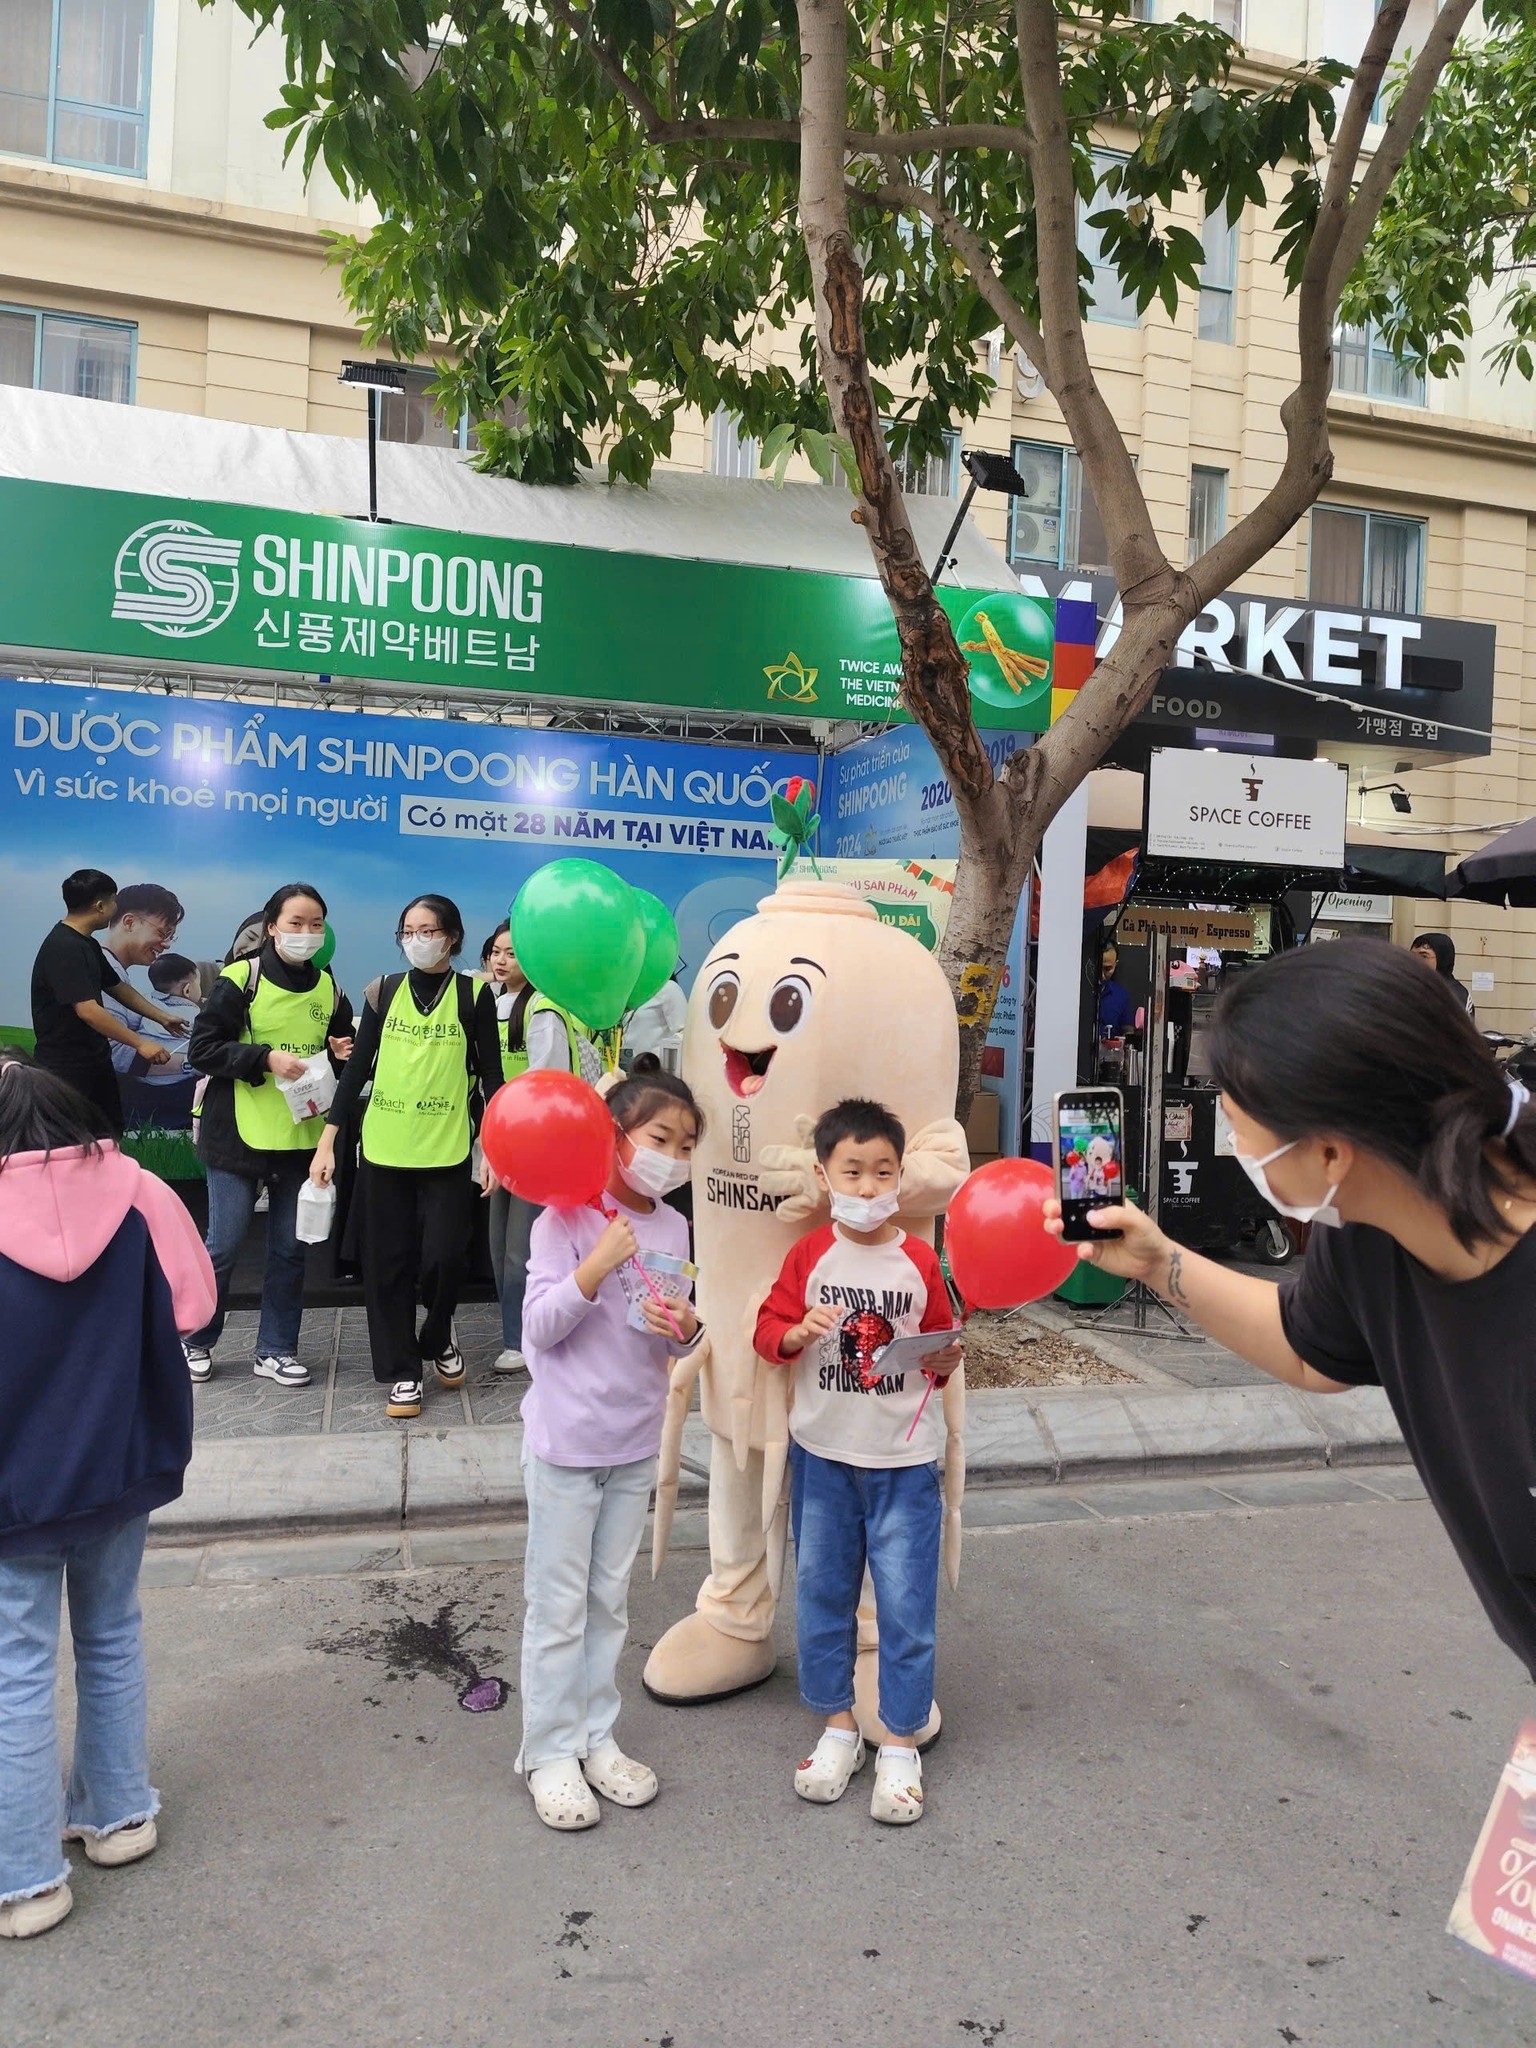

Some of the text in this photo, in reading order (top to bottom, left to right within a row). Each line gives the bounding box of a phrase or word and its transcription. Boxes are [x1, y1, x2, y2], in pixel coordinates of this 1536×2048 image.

[253, 533, 543, 624] SHINPOONG
[253, 608, 541, 672] 신풍제약베트남
[839, 659, 905, 676] TWICE AW
[840, 677, 863, 690] THE
[1152, 695, 1222, 719] FOOD
[1357, 716, 1439, 741] 가맹점 모집
[14, 708, 162, 766] DƯỢC
[172, 712, 307, 771] PHẨM
[317, 737, 581, 793] SHINPOONG
[590, 753, 675, 802] HÀN
[850, 757, 870, 780] phát
[14, 767, 388, 827] Vì sức khoẻ mọi người
[837, 771, 907, 820] SHINPOONG
[407, 804, 446, 828] Có
[455, 811, 508, 837] mặt
[513, 811, 546, 835] 28
[554, 811, 615, 840] NĂM
[622, 819, 662, 849] TẠI
[669, 820, 725, 853] VIỆT
[1189, 805, 1312, 831] SPACE COFFEE
[835, 832, 862, 858] 2024
[799, 865, 838, 875] SHINOONG
[1327, 891, 1373, 912] Opening
[1122, 918, 1135, 932] Cà
[1159, 921, 1178, 935] pha
[1180, 920, 1200, 936] máy
[1206, 924, 1251, 943] Espresso
[385, 1016, 461, 1039] 하노이한인회
[712, 1167, 736, 1178] KOREAN
[736, 1172, 748, 1180] RED
[819, 1284, 913, 1320] SPIDER-MAN
